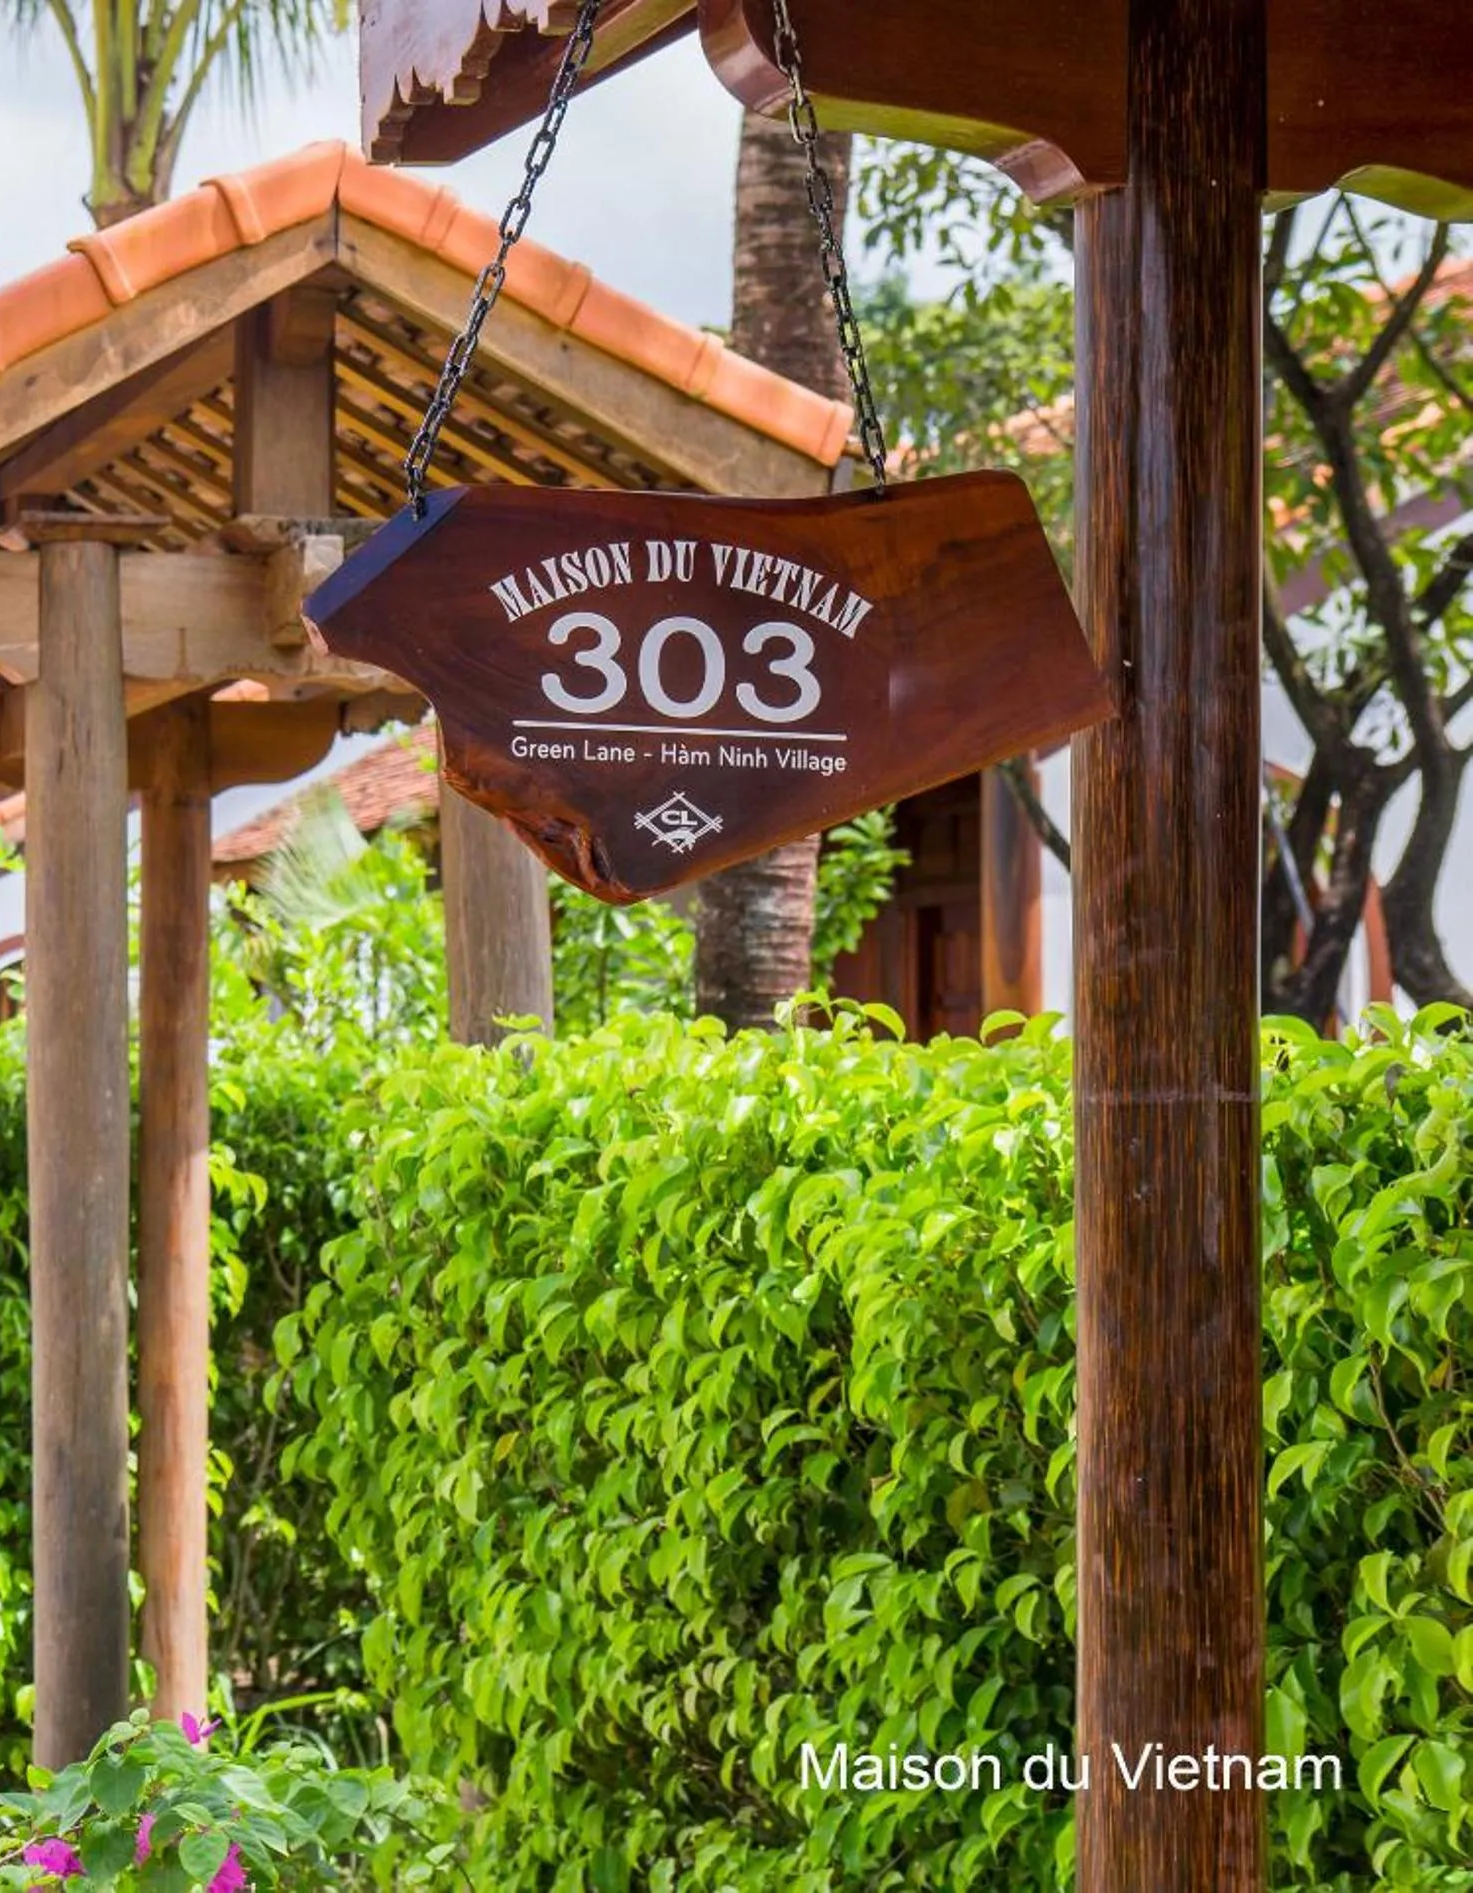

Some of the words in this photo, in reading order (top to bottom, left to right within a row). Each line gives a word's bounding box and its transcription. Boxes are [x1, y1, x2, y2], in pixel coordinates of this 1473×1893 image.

[489, 541, 632, 622] MAISON
[645, 540, 698, 582] DU
[710, 542, 874, 639] VIETNAM
[541, 612, 821, 724] 303
[511, 737, 575, 760] Green
[584, 740, 635, 762] Lane
[661, 743, 710, 765] Hàm
[719, 746, 767, 769] Ninh
[775, 748, 847, 776] Village
[661, 809, 697, 826] CL
